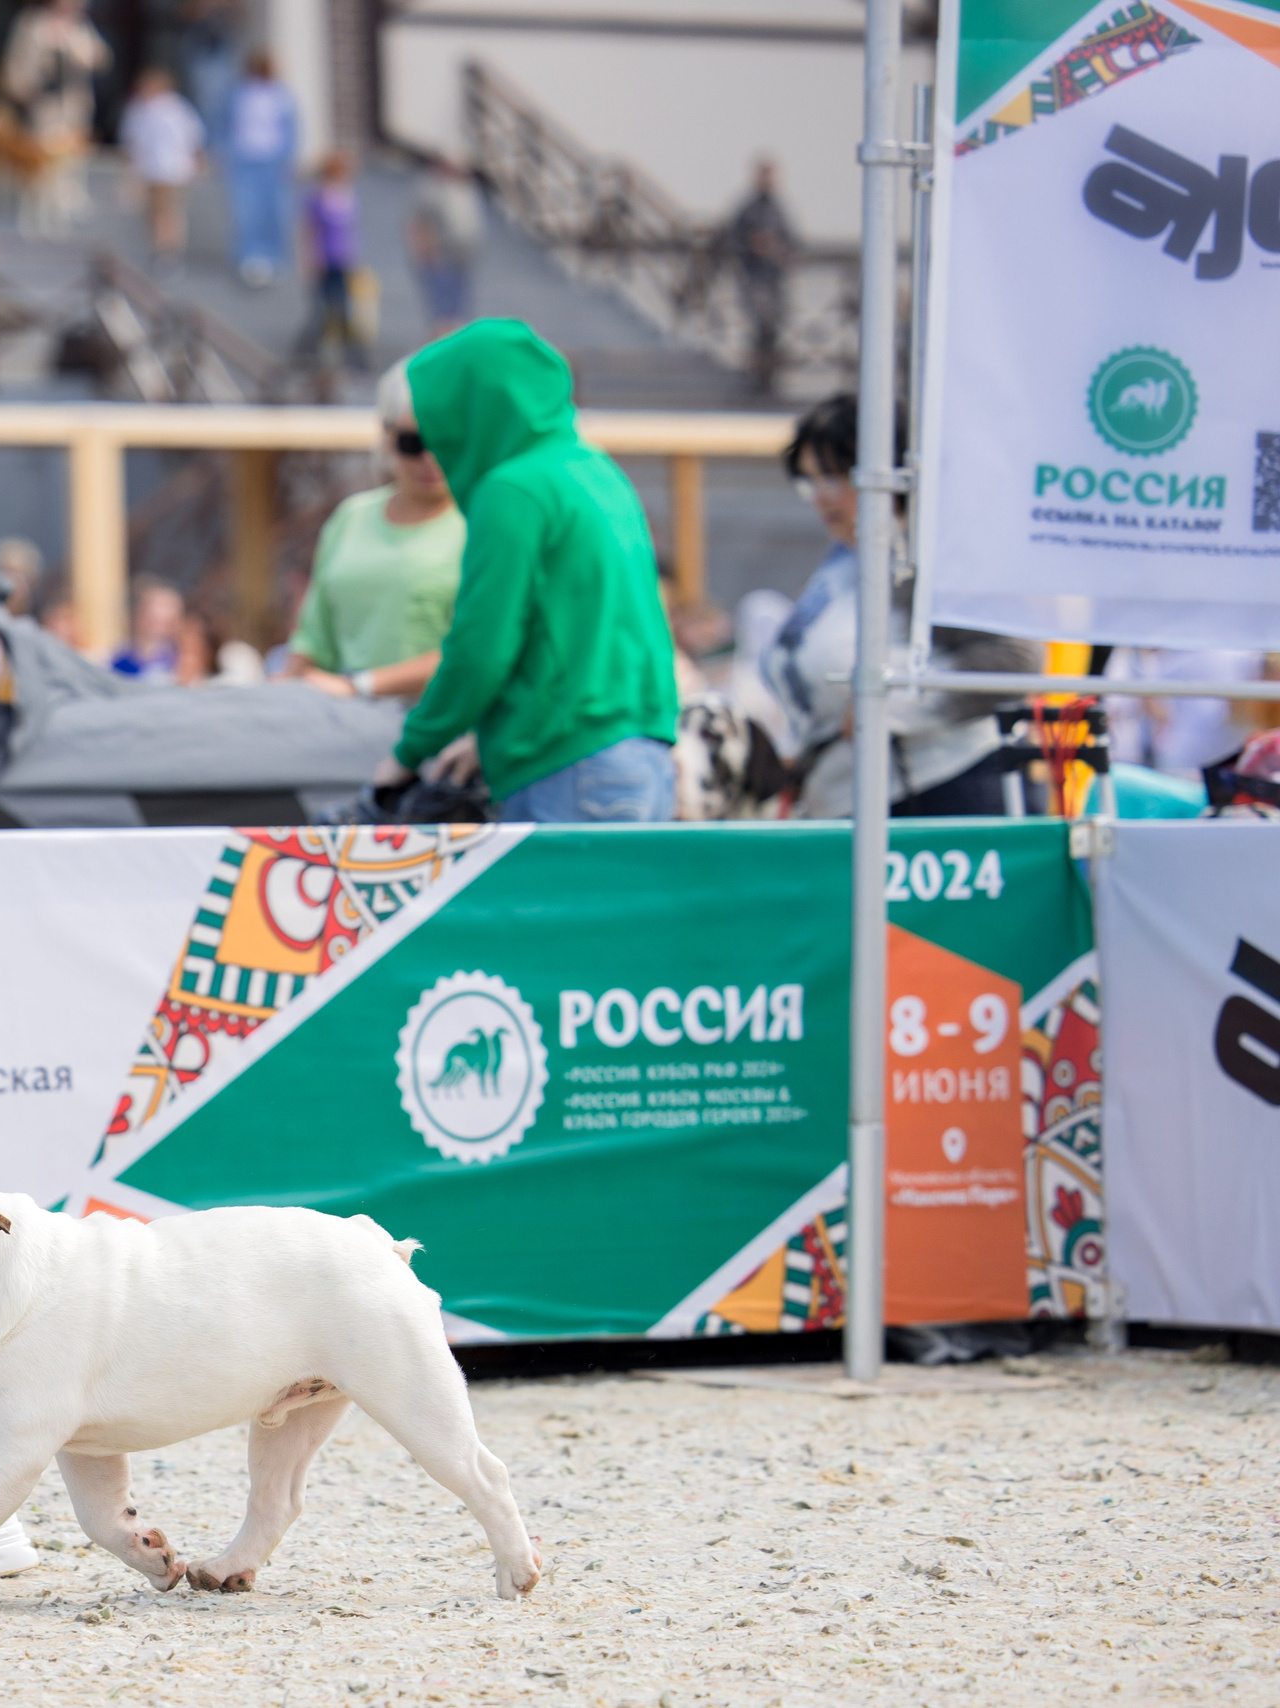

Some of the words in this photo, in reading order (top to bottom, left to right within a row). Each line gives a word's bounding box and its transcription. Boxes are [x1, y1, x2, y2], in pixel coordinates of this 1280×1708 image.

[1035, 464, 1226, 509] РОССИЯ
[885, 849, 1004, 901] 2024
[558, 983, 804, 1049] РОССИЯ
[892, 1066, 1010, 1103] ИЮНЯ
